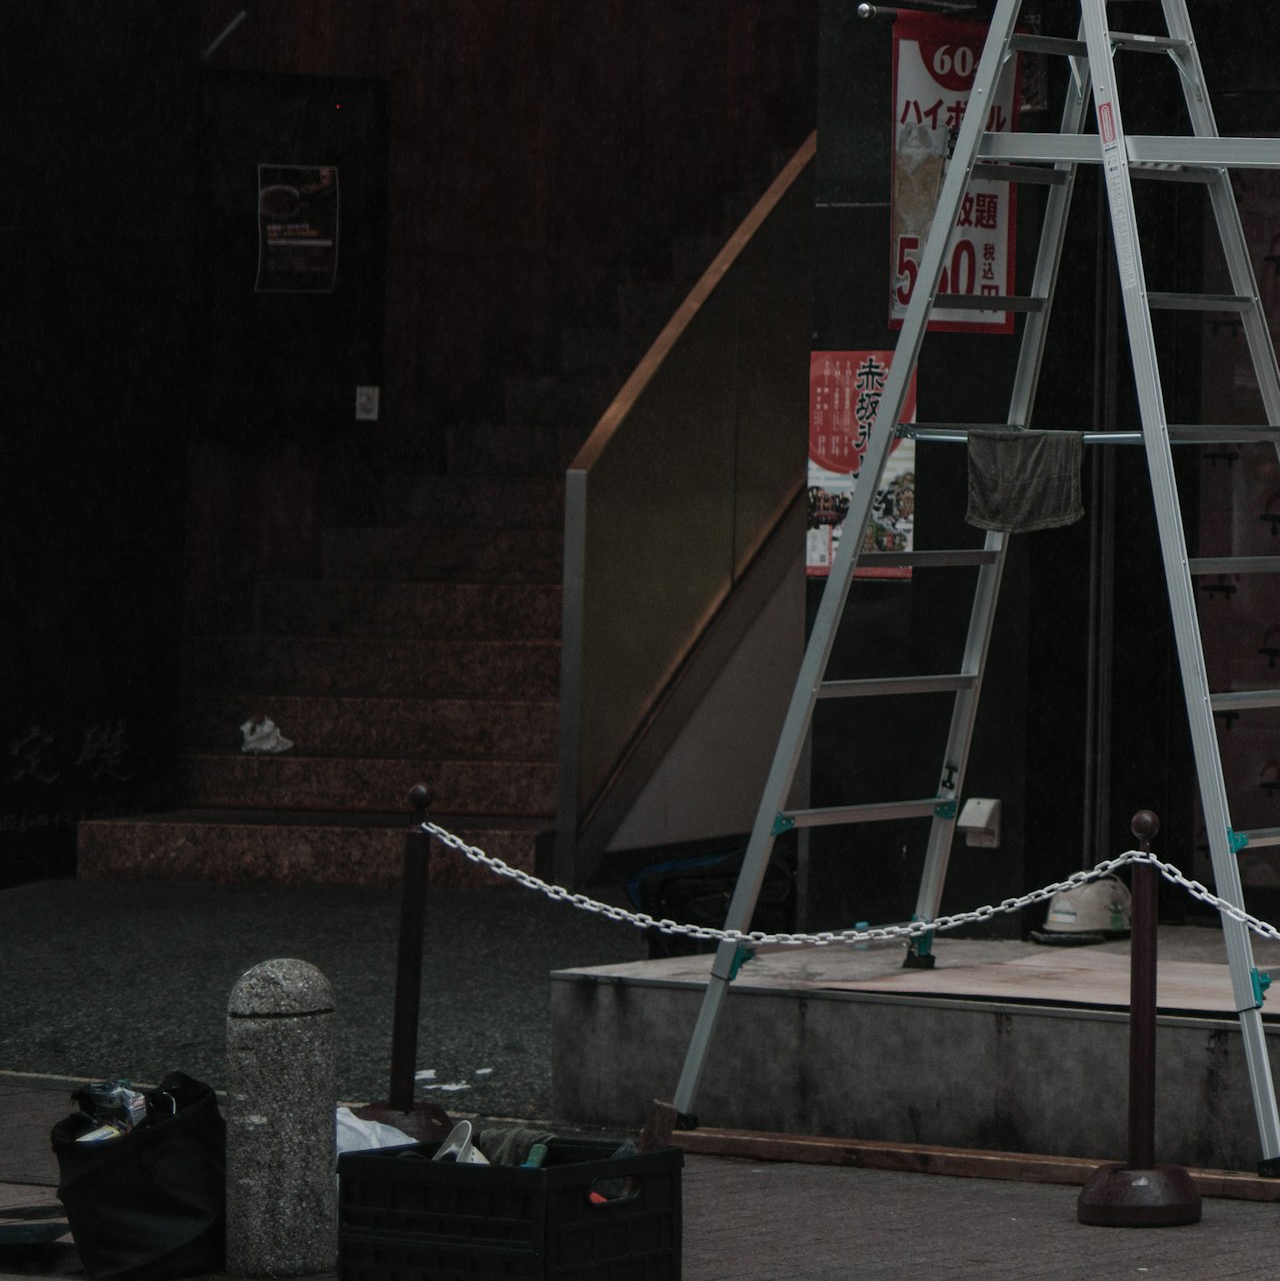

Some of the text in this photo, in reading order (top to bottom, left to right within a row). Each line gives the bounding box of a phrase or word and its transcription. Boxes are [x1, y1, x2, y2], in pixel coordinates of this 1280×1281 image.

[900, 97, 1007, 132] ハイボル
[897, 236, 976, 306] 50
[981, 242, 996, 281] 税込
